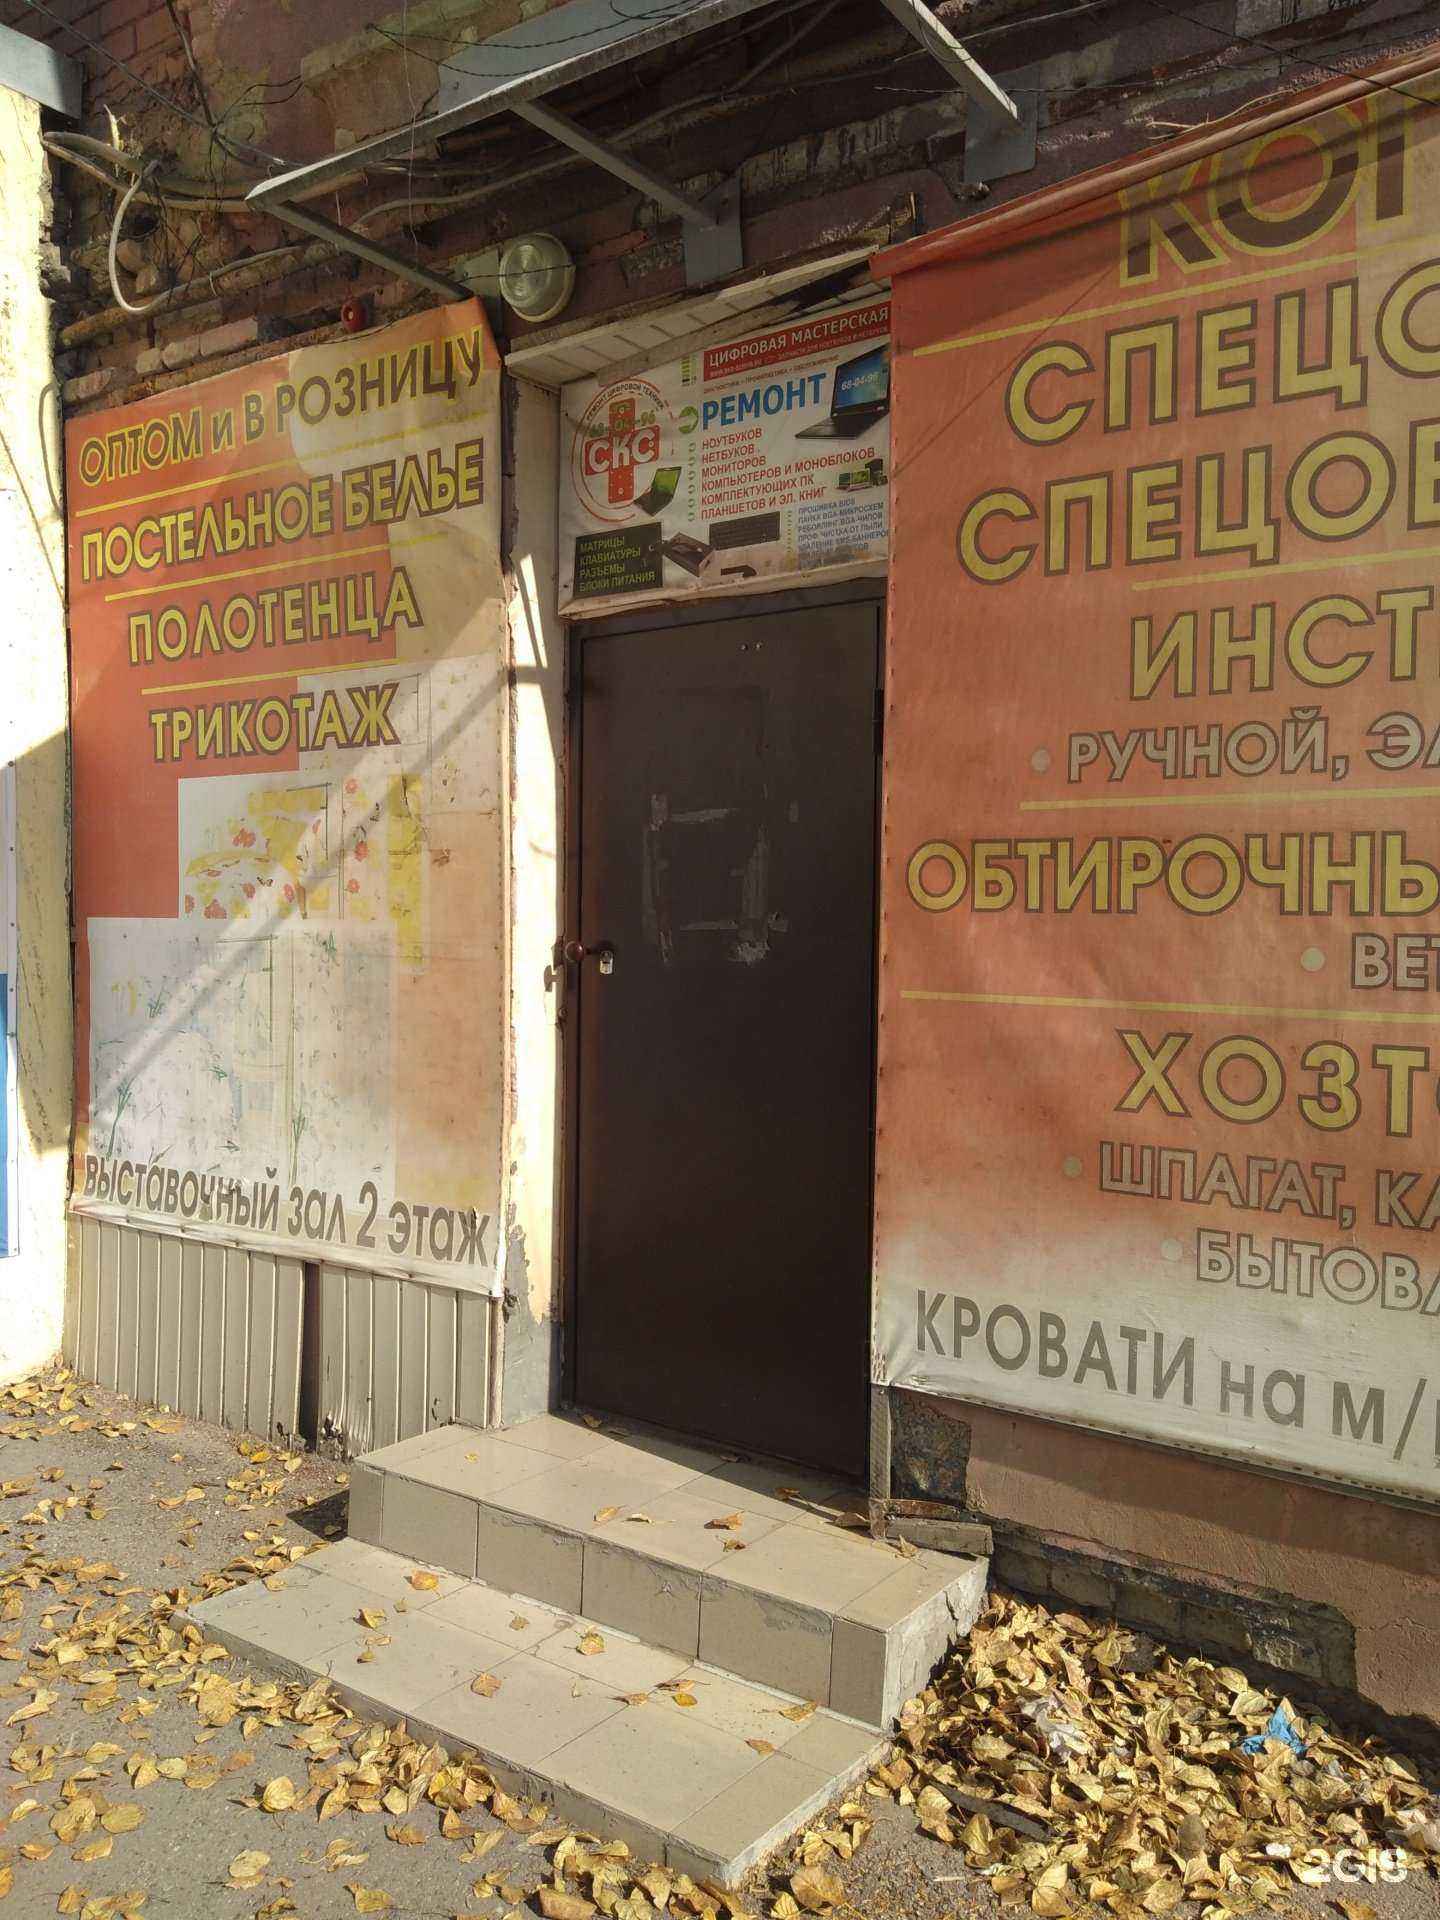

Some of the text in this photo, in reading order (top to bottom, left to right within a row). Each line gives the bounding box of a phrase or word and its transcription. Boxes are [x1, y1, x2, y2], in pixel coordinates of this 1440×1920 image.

[709, 334, 787, 368] ЦИФРОВАЯ
[791, 307, 889, 346] МАСТЕРСКАЯ
[79, 405, 202, 487] ОПТОМ
[242, 390, 266, 445] В
[275, 328, 482, 434] РОЗНИЦУ
[702, 372, 827, 431] РЕМОНТ
[588, 428, 656, 473] СКС
[702, 428, 763, 450] НОУТБУКОВ
[702, 444, 755, 465] НЕТБУКОВ
[702, 455, 767, 478] МОНИТОРОВ
[701, 447, 875, 493] КОМПЬЮТЕРОВ И МОНОБЛОКОВ
[701, 473, 815, 507] КОМПЛЕКТУЮЩИХ ПК
[81, 437, 484, 584] ПОСТЕЛЬНОЕ БЕЛЬЕ
[701, 498, 767, 521] ПЛАНШЕТОВ
[768, 495, 778, 507] И
[799, 486, 828, 502] КНИГ
[579, 536, 625, 552] МАТРИЦЫ
[579, 547, 641, 566] КЛАВИАТУРЫ
[579, 563, 625, 578] РАЗЪЕМЫ
[579, 571, 656, 593] БЛОКИ ПИТАНИЯ
[128, 566, 424, 667] ПОЛОТЕНЦА
[1130, 585, 1440, 701] ИНСТ
[149, 682, 400, 764] ТРИКОТАЖ
[1067, 706, 1349, 784] РУЧНОЙ,
[1351, 932, 1440, 993] ВЕ
[1113, 1028, 1440, 1138] ХОЗТ
[1099, 1140, 1357, 1231] ШПАГАТ,
[287, 1186, 346, 1244] зал
[355, 1180, 379, 1249] 2
[387, 1200, 490, 1267] этаж
[916, 1289, 1196, 1407] КРОВАТИ
[1219, 1359, 1306, 1429] на
